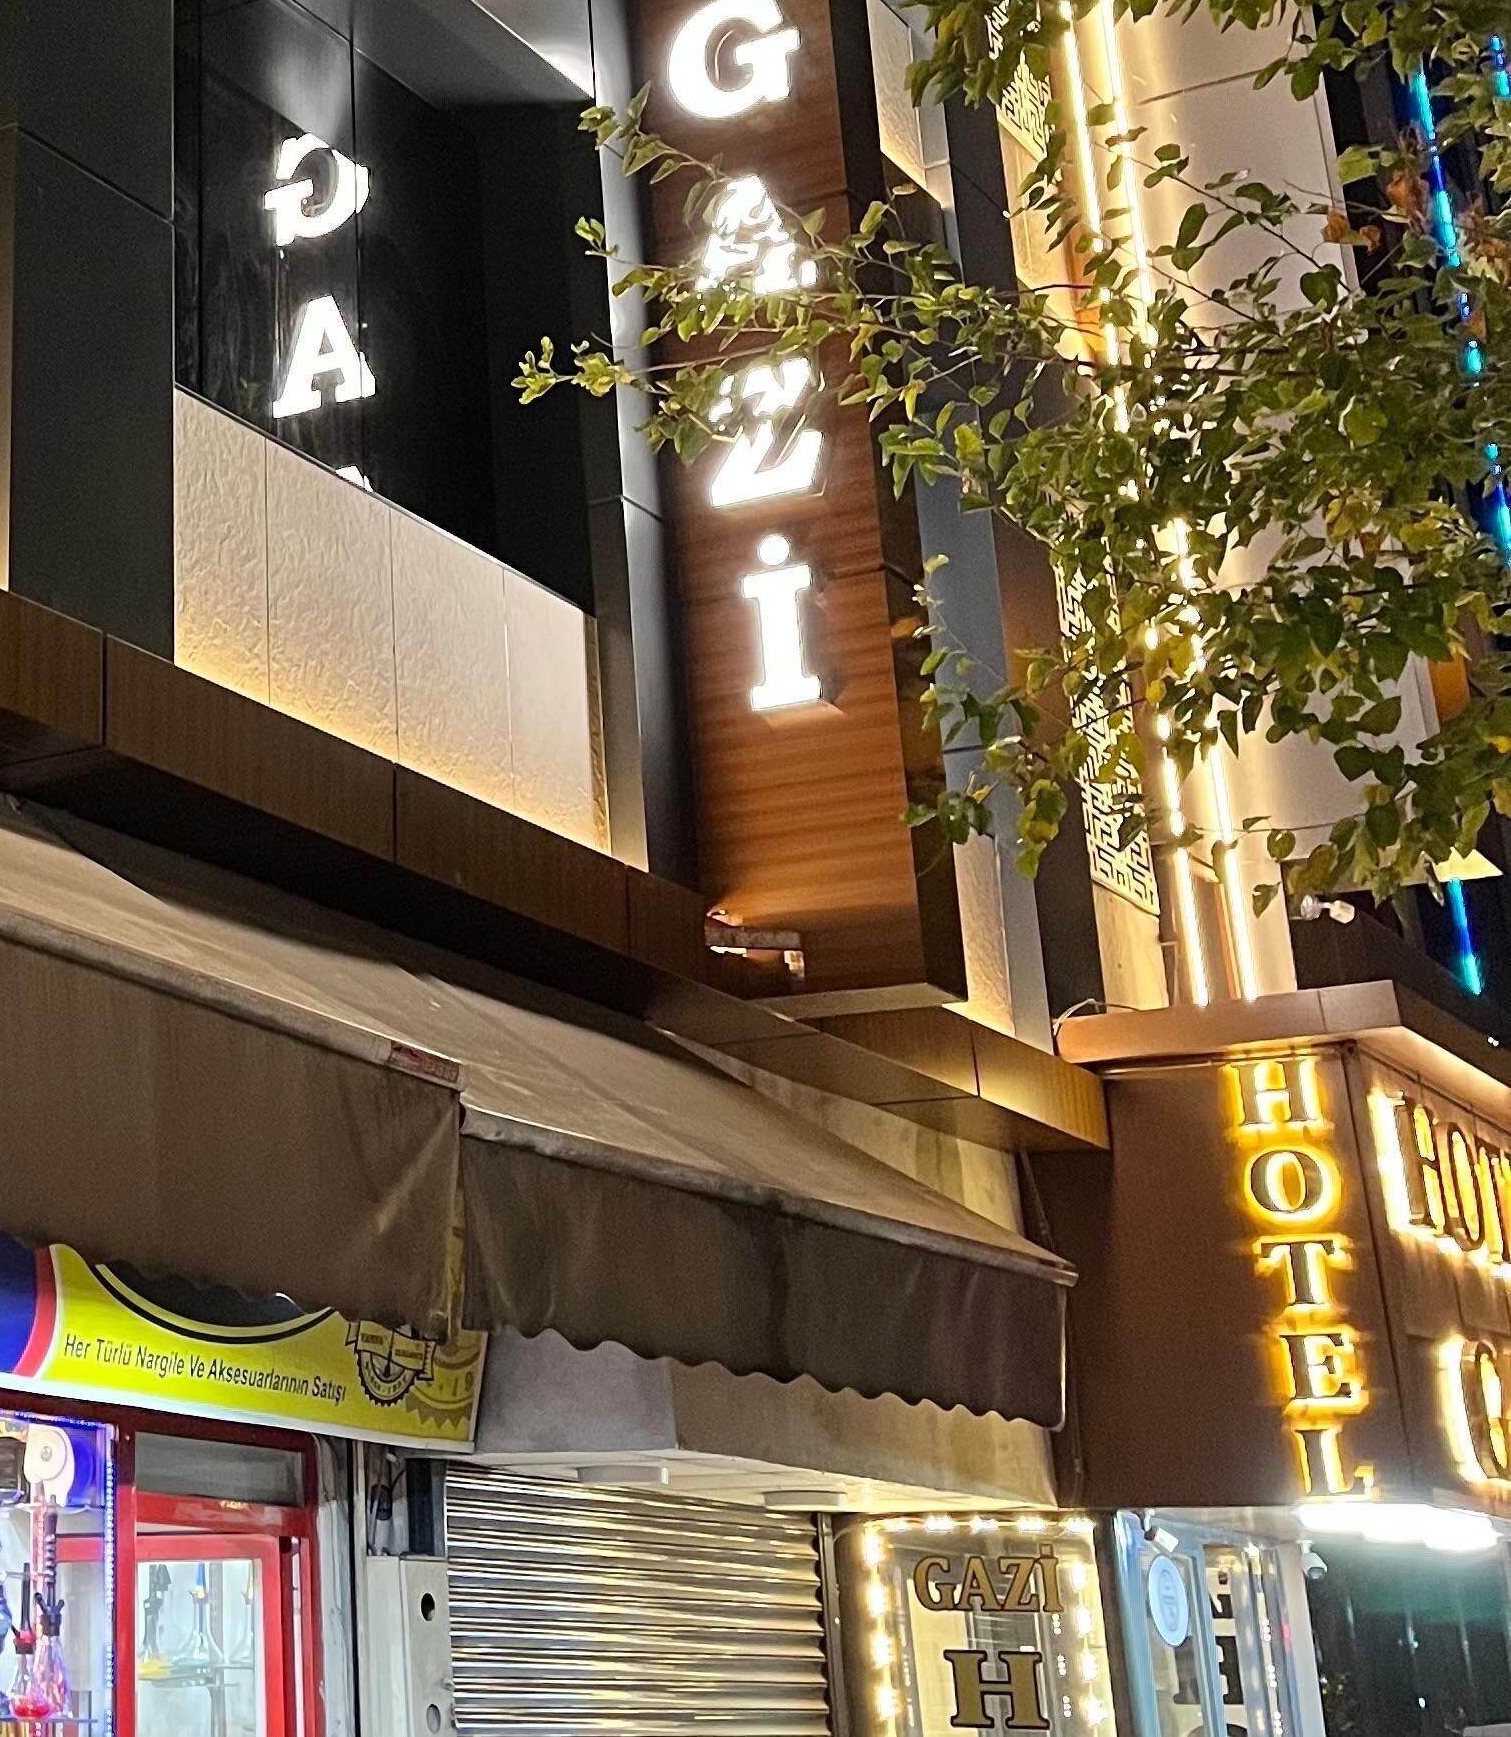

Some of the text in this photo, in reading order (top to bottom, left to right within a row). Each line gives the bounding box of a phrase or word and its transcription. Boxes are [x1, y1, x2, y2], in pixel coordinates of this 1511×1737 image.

[1221, 1059, 1375, 1500] HOTEL
[64, 1334, 90, 1359] Her
[96, 1338, 132, 1365] Türlü
[136, 1346, 185, 1378] Nargile
[190, 1355, 206, 1378] Ve
[312, 1376, 347, 1407] Satışı
[912, 1543, 1065, 1613] GAZİ
[943, 1649, 1051, 1730] H
